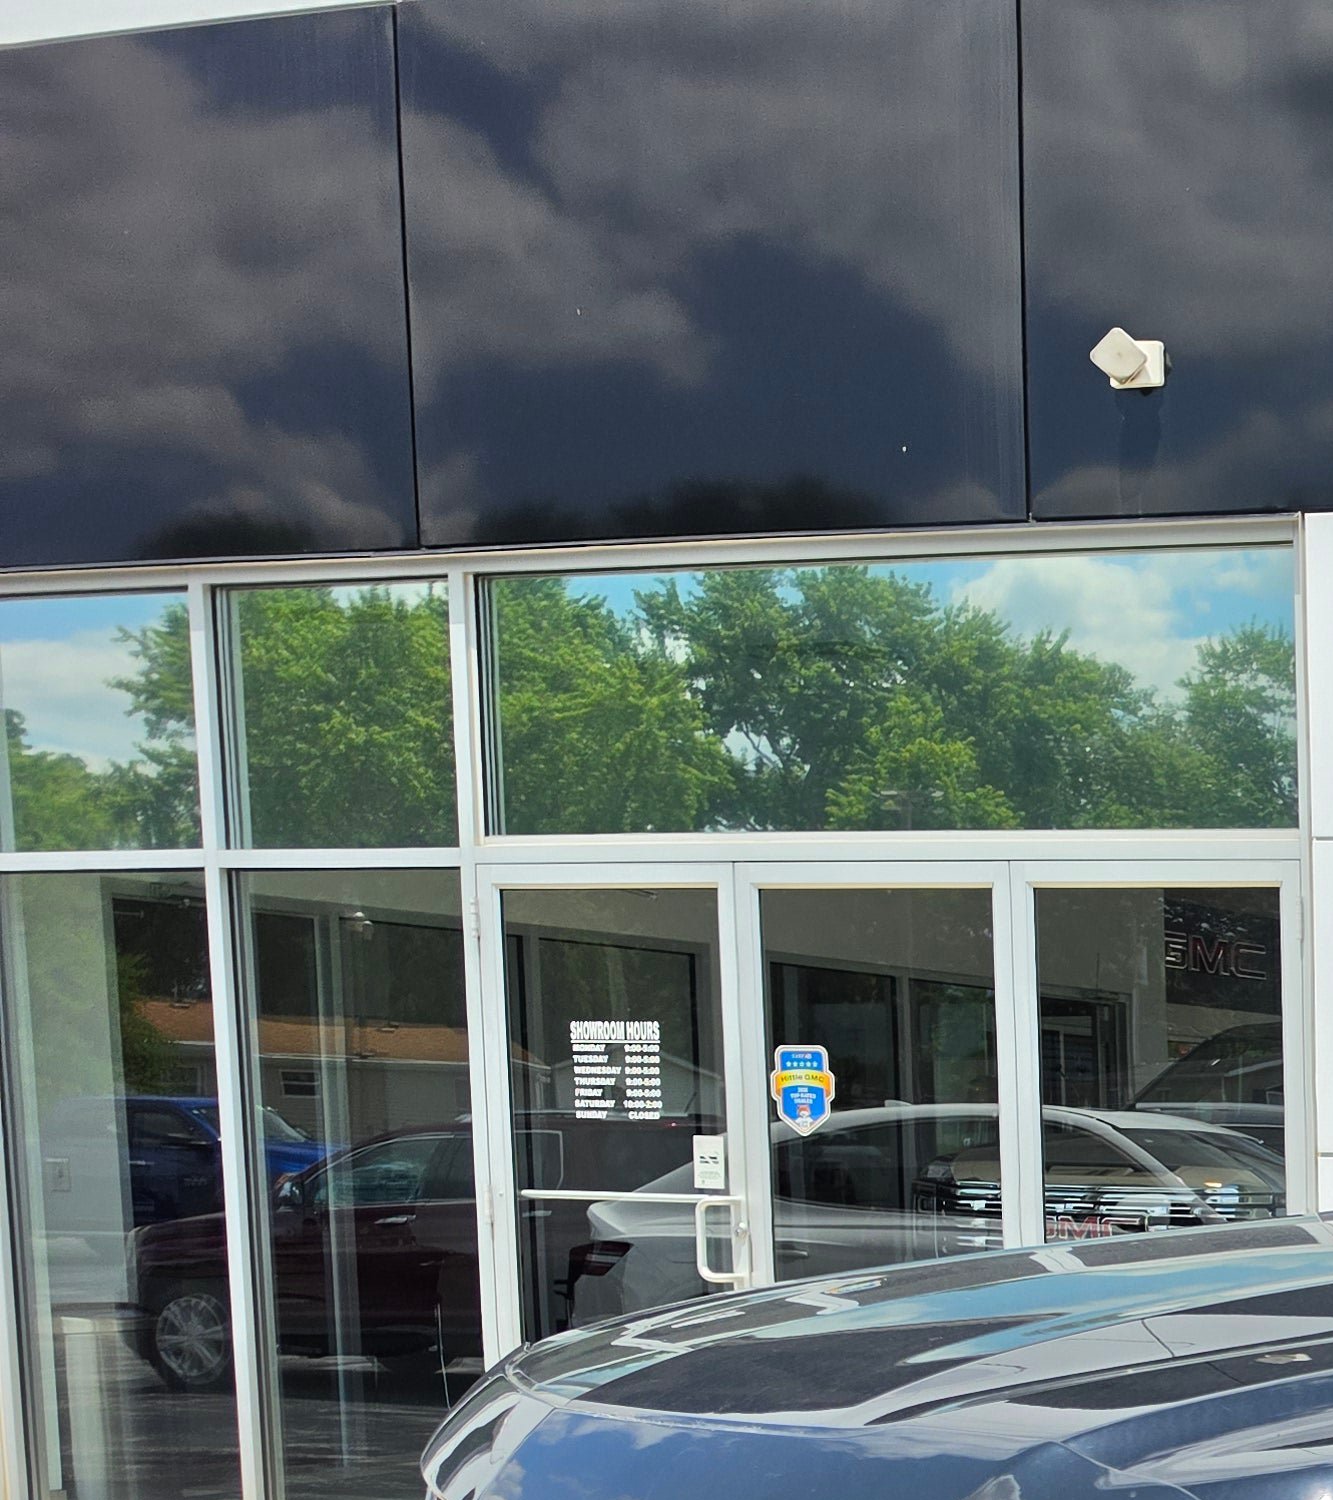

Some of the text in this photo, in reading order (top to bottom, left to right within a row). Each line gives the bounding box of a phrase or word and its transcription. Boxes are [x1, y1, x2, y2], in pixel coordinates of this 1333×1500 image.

[570, 1020, 660, 1040] SHOWROOM HOURS
[573, 1066, 622, 1075] WEDNESDAY
[573, 1077, 616, 1086] THURSDAY
[574, 1099, 616, 1108] SATURDAY
